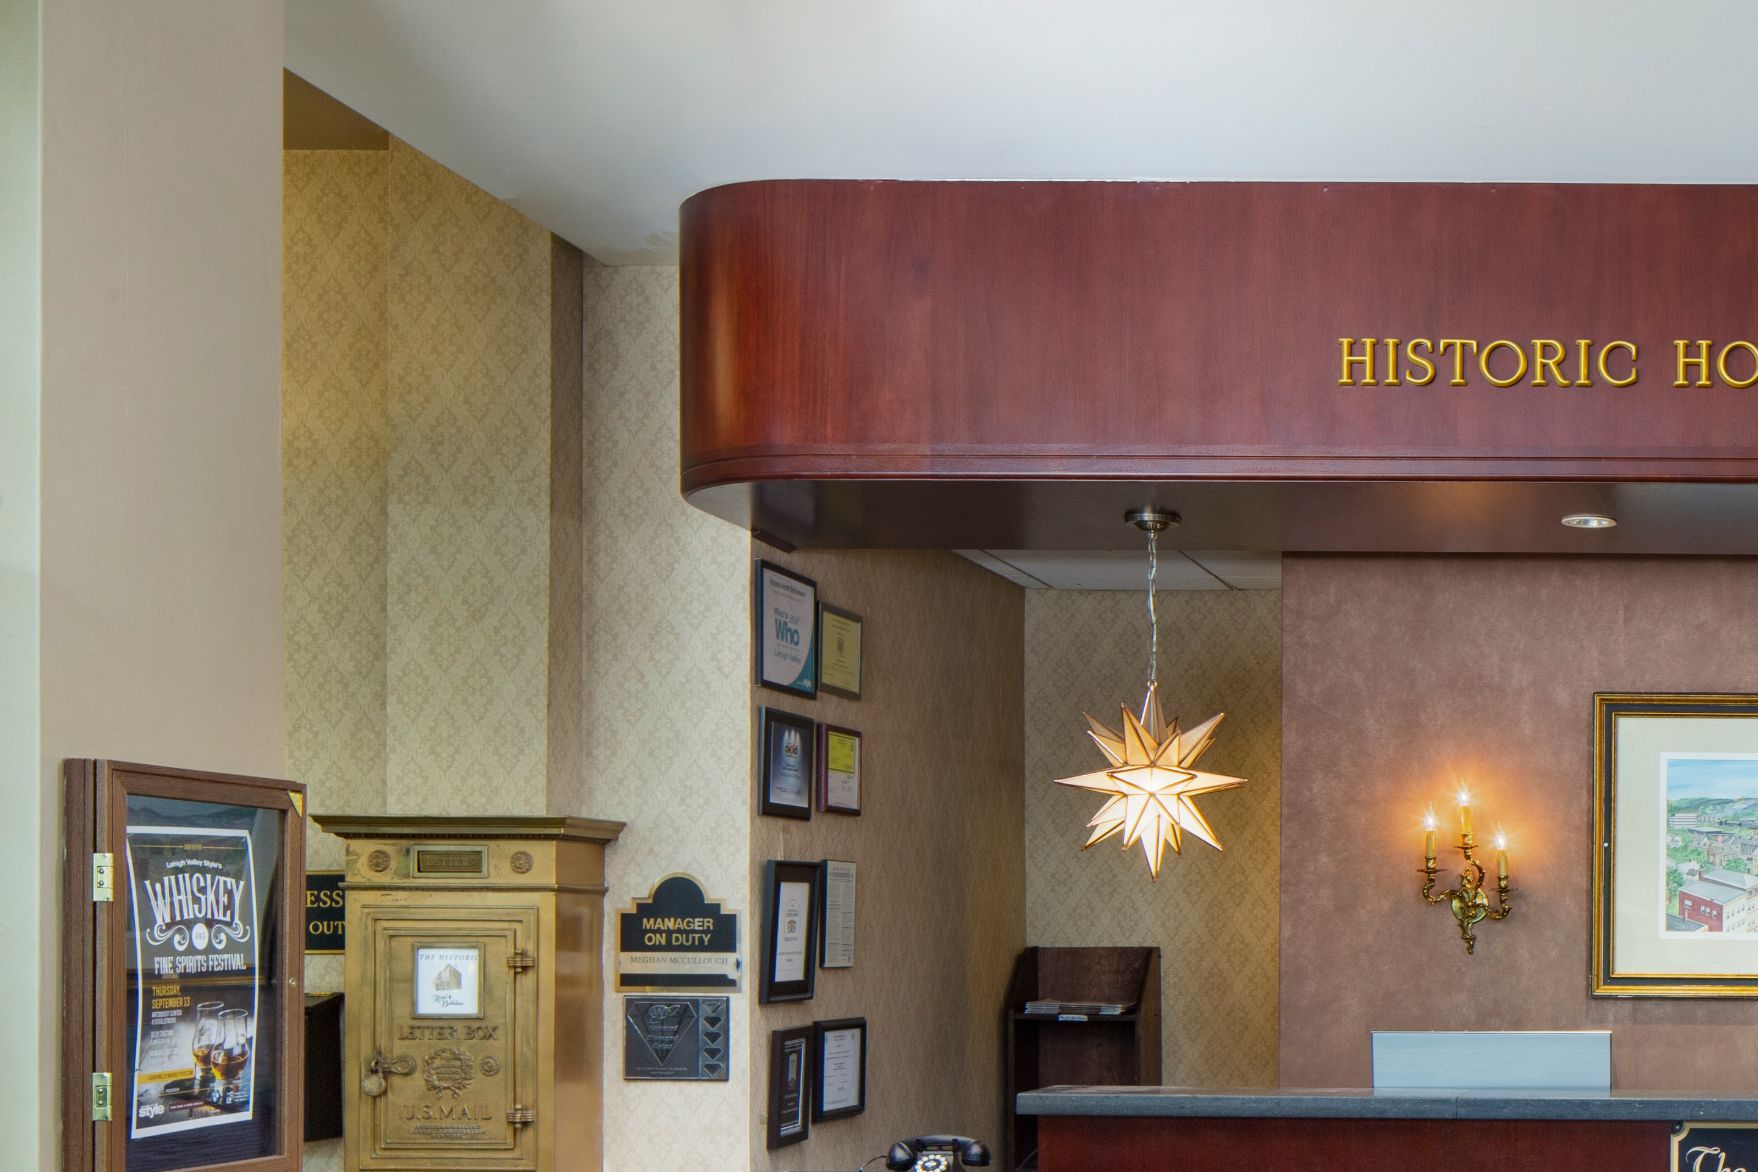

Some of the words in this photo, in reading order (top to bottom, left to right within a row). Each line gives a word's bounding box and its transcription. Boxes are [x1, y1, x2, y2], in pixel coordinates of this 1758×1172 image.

[1337, 337, 1639, 388] HISTORIC
[774, 616, 801, 647] Who
[166, 860, 185, 869] Lehigh
[186, 858, 203, 868] Valley
[143, 872, 246, 926] WHISKEY
[309, 920, 345, 935] OUT
[642, 917, 714, 931] MANAGER
[644, 932, 667, 946] ON
[671, 932, 712, 946] DUTY
[154, 956, 174, 975] FINE
[175, 955, 207, 974] SPIRITS
[208, 953, 247, 972] FESTIVAL
[419, 953, 436, 961] THE
[630, 955, 668, 965] MEGHAN
[151, 984, 181, 997] THURSDAY,
[151, 997, 184, 1010] SEPTEMBER
[183, 996, 191, 1008] 13
[397, 1024, 458, 1041] LETTER
[463, 1024, 499, 1041] BOX
[138, 1103, 165, 1119] style
